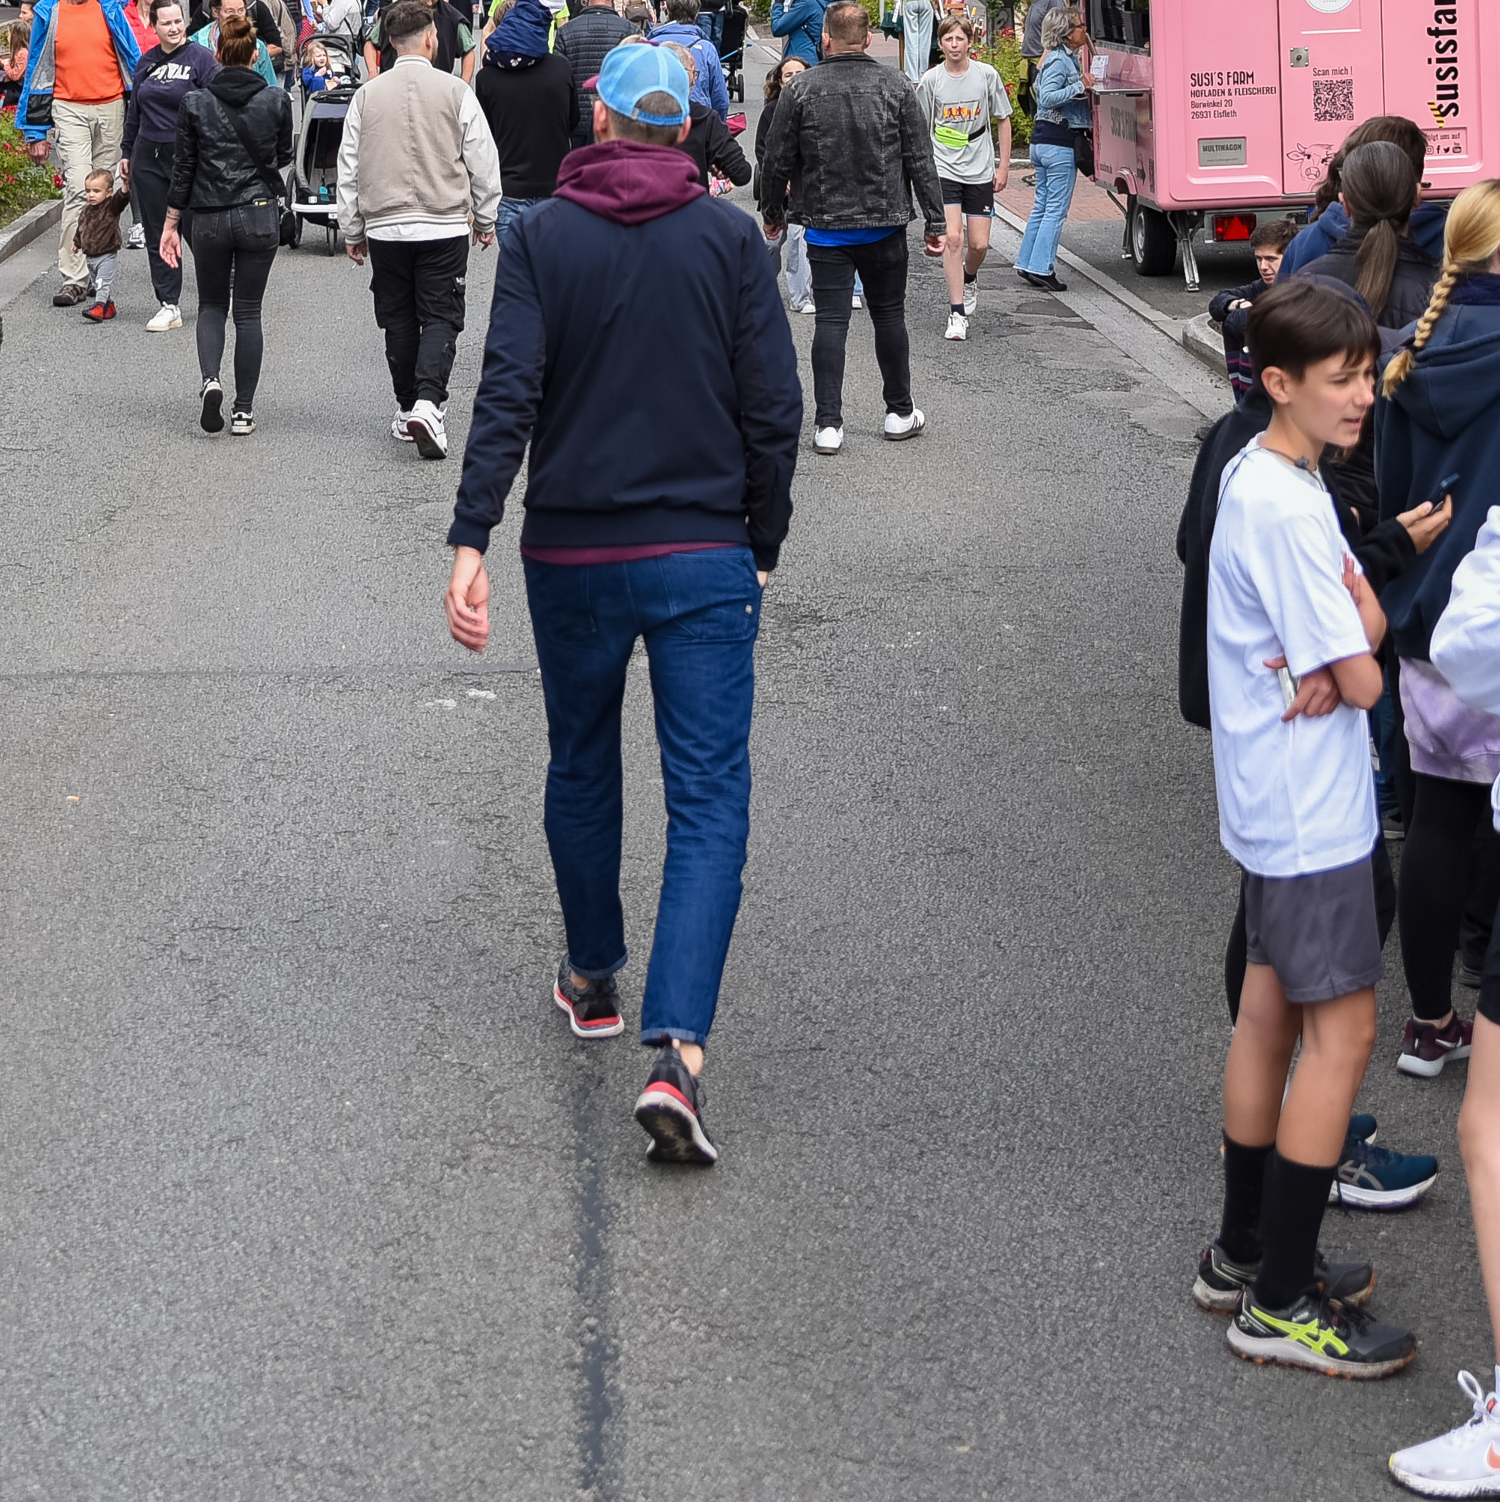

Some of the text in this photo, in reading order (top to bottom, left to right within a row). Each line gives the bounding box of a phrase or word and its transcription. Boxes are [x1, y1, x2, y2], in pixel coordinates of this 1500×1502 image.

[1312, 67, 1330, 77] Scan
[1331, 66, 1349, 76] mich
[1227, 71, 1254, 86] FARM
[1190, 87, 1276, 98] HOFLADEN & FLEISCHEREI
[1224, 99, 1233, 107] 20
[1191, 111, 1211, 119] 26931
